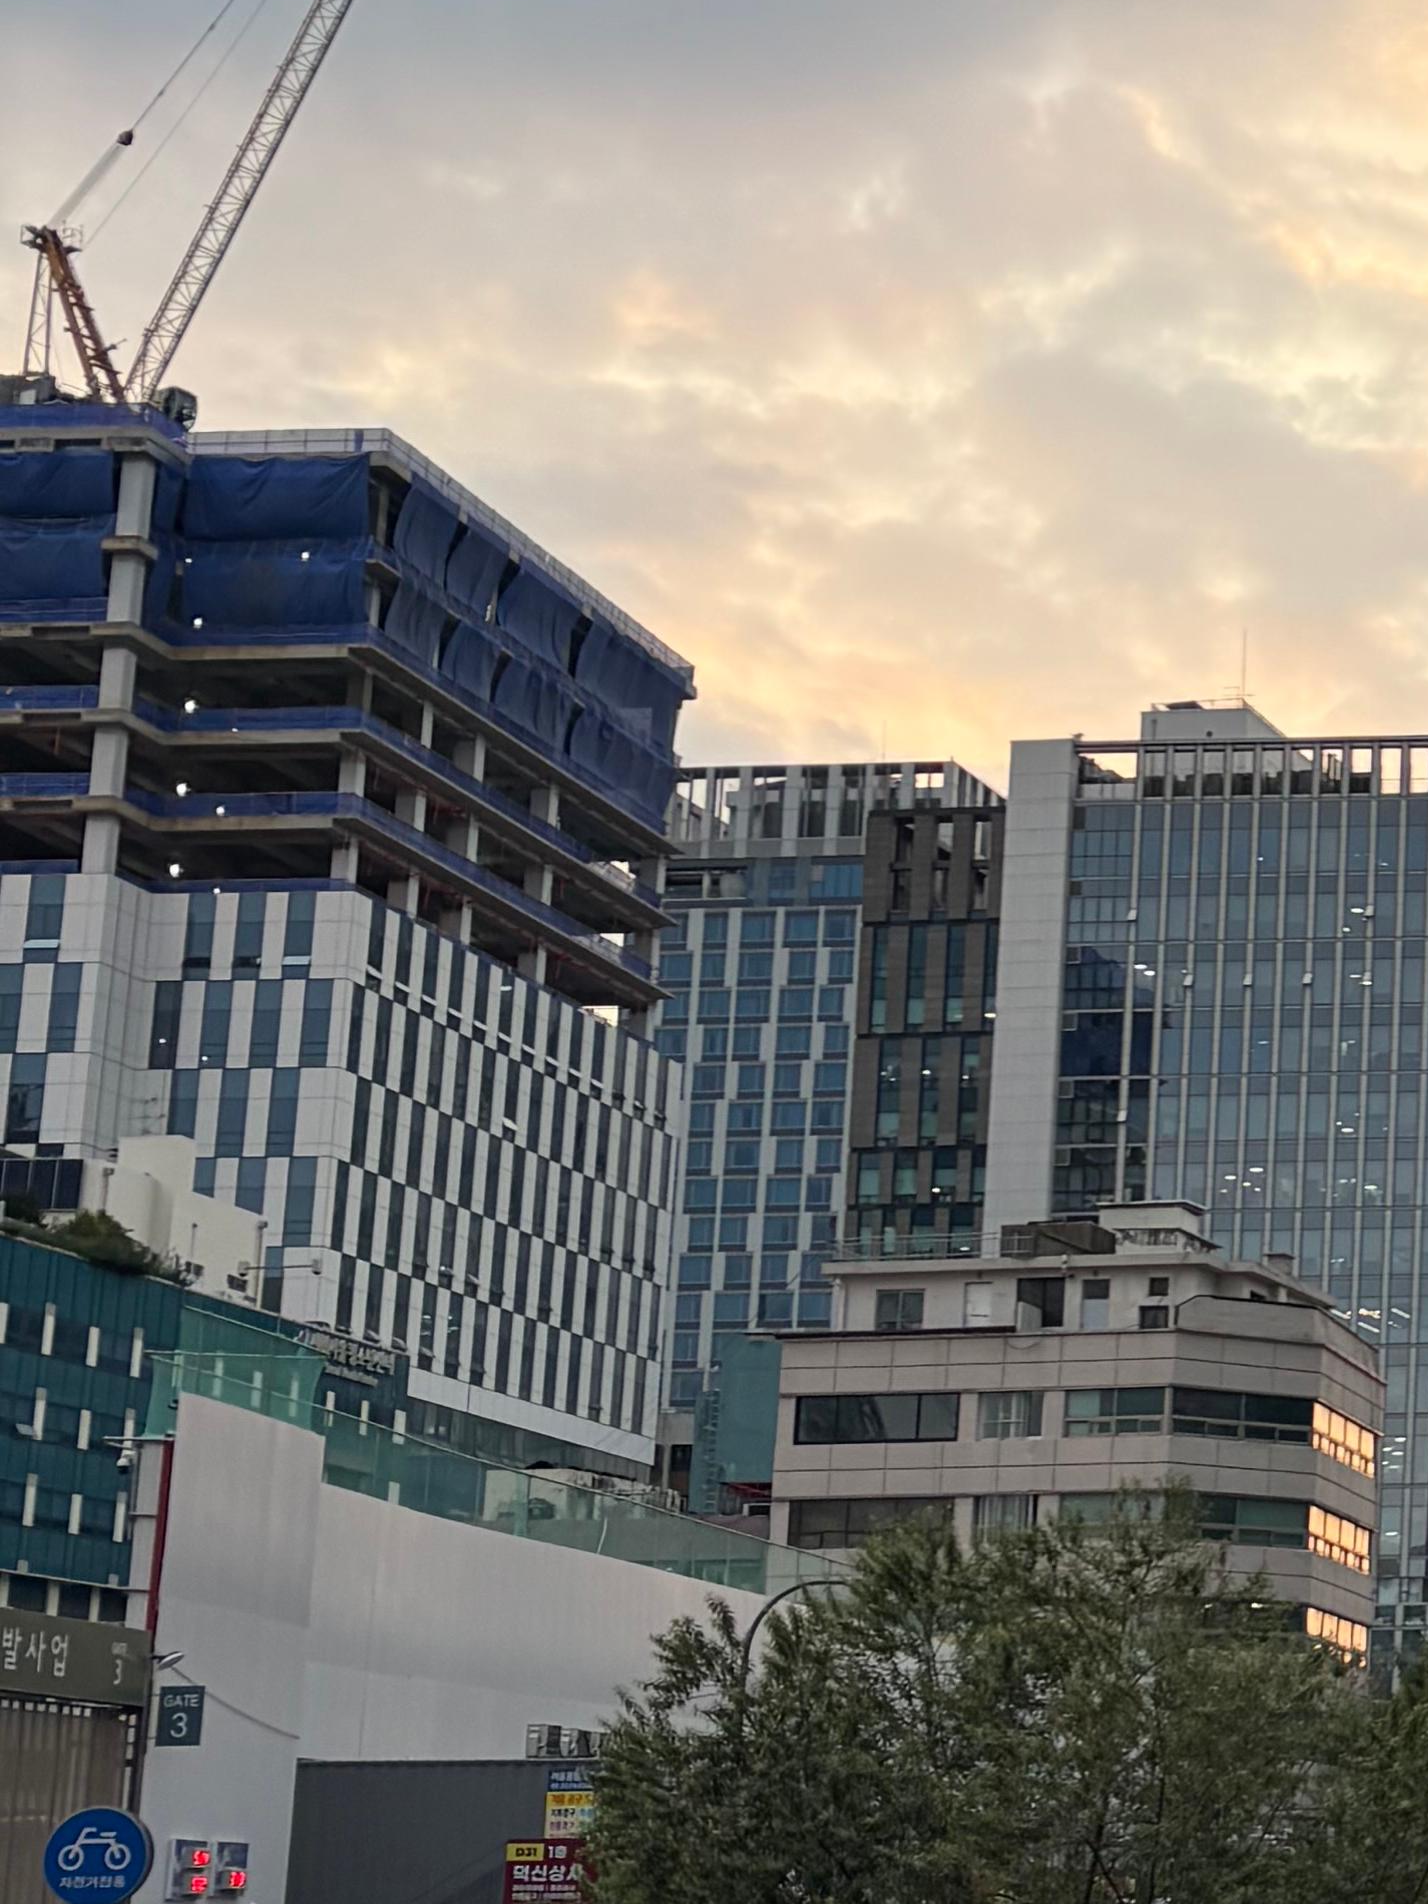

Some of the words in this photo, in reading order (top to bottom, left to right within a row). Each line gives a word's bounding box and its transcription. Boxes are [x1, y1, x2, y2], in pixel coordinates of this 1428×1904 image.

[2, 1626, 70, 1677] 발사업
[163, 1693, 200, 1708] GATE
[169, 1712, 188, 1738] 3
